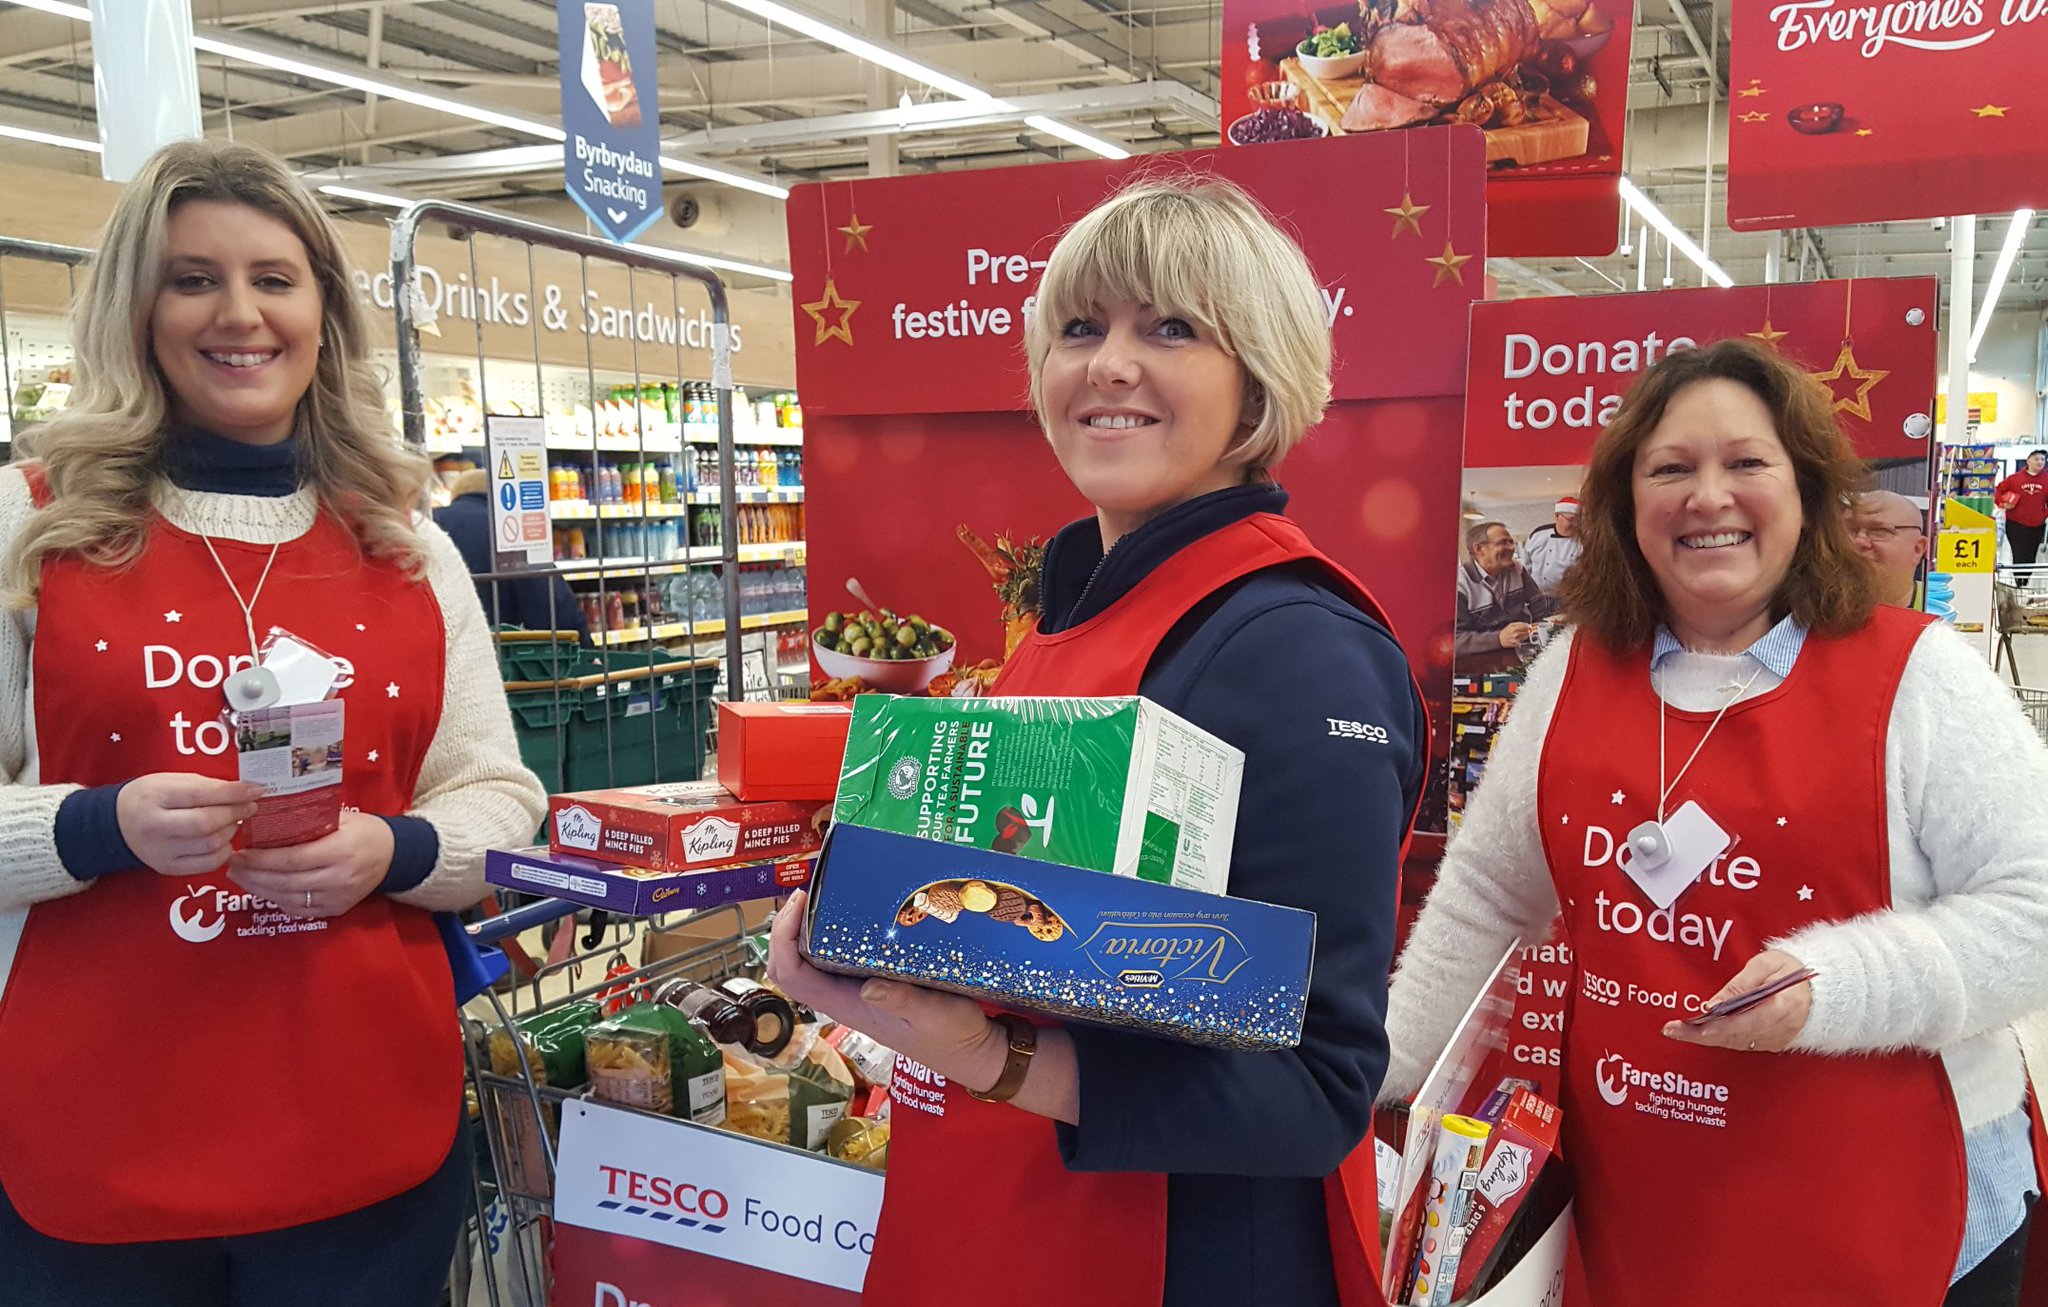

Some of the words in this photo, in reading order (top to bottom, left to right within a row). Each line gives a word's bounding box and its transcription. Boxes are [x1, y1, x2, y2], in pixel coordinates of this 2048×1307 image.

[2000, 0, 2048, 26] w
[575, 134, 653, 178] Byrbrydau
[584, 168, 647, 211] Snacking
[414, 264, 529, 326] Drinks
[543, 284, 568, 331] &
[579, 289, 741, 352] Sandwichs
[892, 300, 1011, 339] festive
[1954, 538, 1981, 560] £1
[1956, 560, 1978, 569] each
[143, 645, 356, 690] Done
[170, 710, 241, 756] to
[1326, 718, 1387, 739] TESCO
[942, 720, 960, 780] FARMERS
[950, 721, 971, 801] SUSTAINABLE
[917, 720, 947, 839] SUPPORTING
[954, 721, 993, 843] FUTURE
[937, 783, 949, 808] TEA
[948, 804, 956, 813] A
[561, 821, 597, 846] Kipling
[605, 829, 610, 838] 6
[611, 830, 628, 840] DEEP
[630, 832, 654, 845] FILLED
[704, 824, 718, 836] Mr
[744, 831, 750, 839] 6
[752, 827, 773, 838] DEEP
[774, 824, 800, 835] FILLED
[932, 812, 944, 841] OUR
[605, 839, 628, 851] MINCE
[629, 843, 644, 854] PIES
[688, 834, 733, 856] Kipling
[744, 838, 771, 849] MINCE
[773, 835, 790, 845] PIES
[237, 925, 276, 936] tackling
[277, 922, 297, 933] food
[298, 920, 328, 931] waste
[252, 912, 291, 925] fighting
[1595, 890, 1734, 961] today
[1101, 935, 1227, 980] Victoria
[1584, 970, 1621, 998] ESCO
[1628, 984, 1677, 1008] Food
[913, 1083, 946, 1104] hunger,
[1621, 1062, 1729, 1102] FareShare
[902, 1091, 919, 1108] food
[919, 1101, 945, 1117] waste
[1635, 1101, 1669, 1119] tackling
[1670, 1108, 1694, 1122] food
[1695, 1115, 1727, 1128] waste
[1649, 1092, 1686, 1110] fighting
[1687, 1099, 1727, 1117] hunger,
[1480, 1145, 1518, 1192] Kipling
[599, 1165, 729, 1219] TESCO
[744, 1197, 823, 1244] Food
